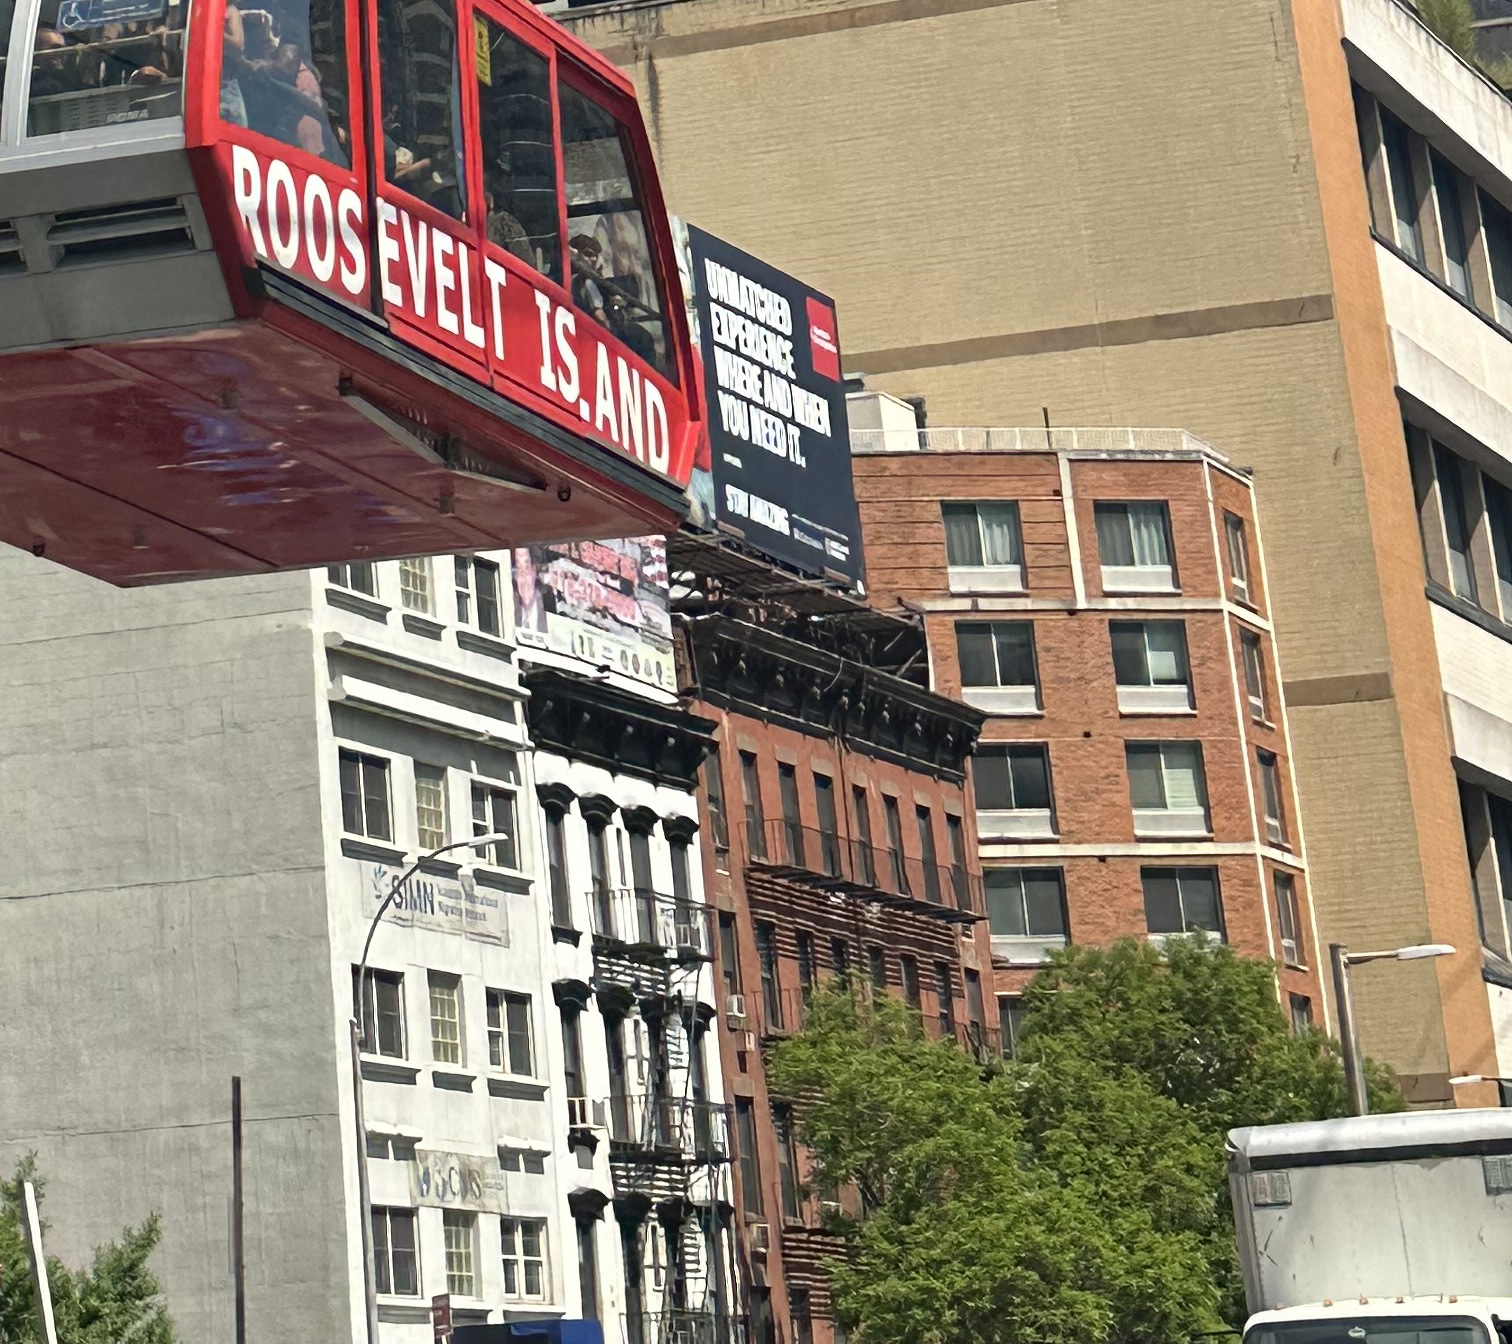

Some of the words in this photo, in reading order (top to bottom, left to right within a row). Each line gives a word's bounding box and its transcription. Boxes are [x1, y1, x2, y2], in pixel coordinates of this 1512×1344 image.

[232, 144, 507, 360] ROOSEVELT
[534, 288, 670, 475] ISAND
[704, 257, 793, 336] UNMATCHED
[709, 301, 797, 380] EXPERIENCE
[713, 344, 764, 405] WHERE
[763, 369, 793, 419] AND
[790, 383, 832, 438] WHEN
[717, 389, 750, 441] YOU
[749, 404, 787, 458] NEED
[787, 422, 806, 468] IT.
